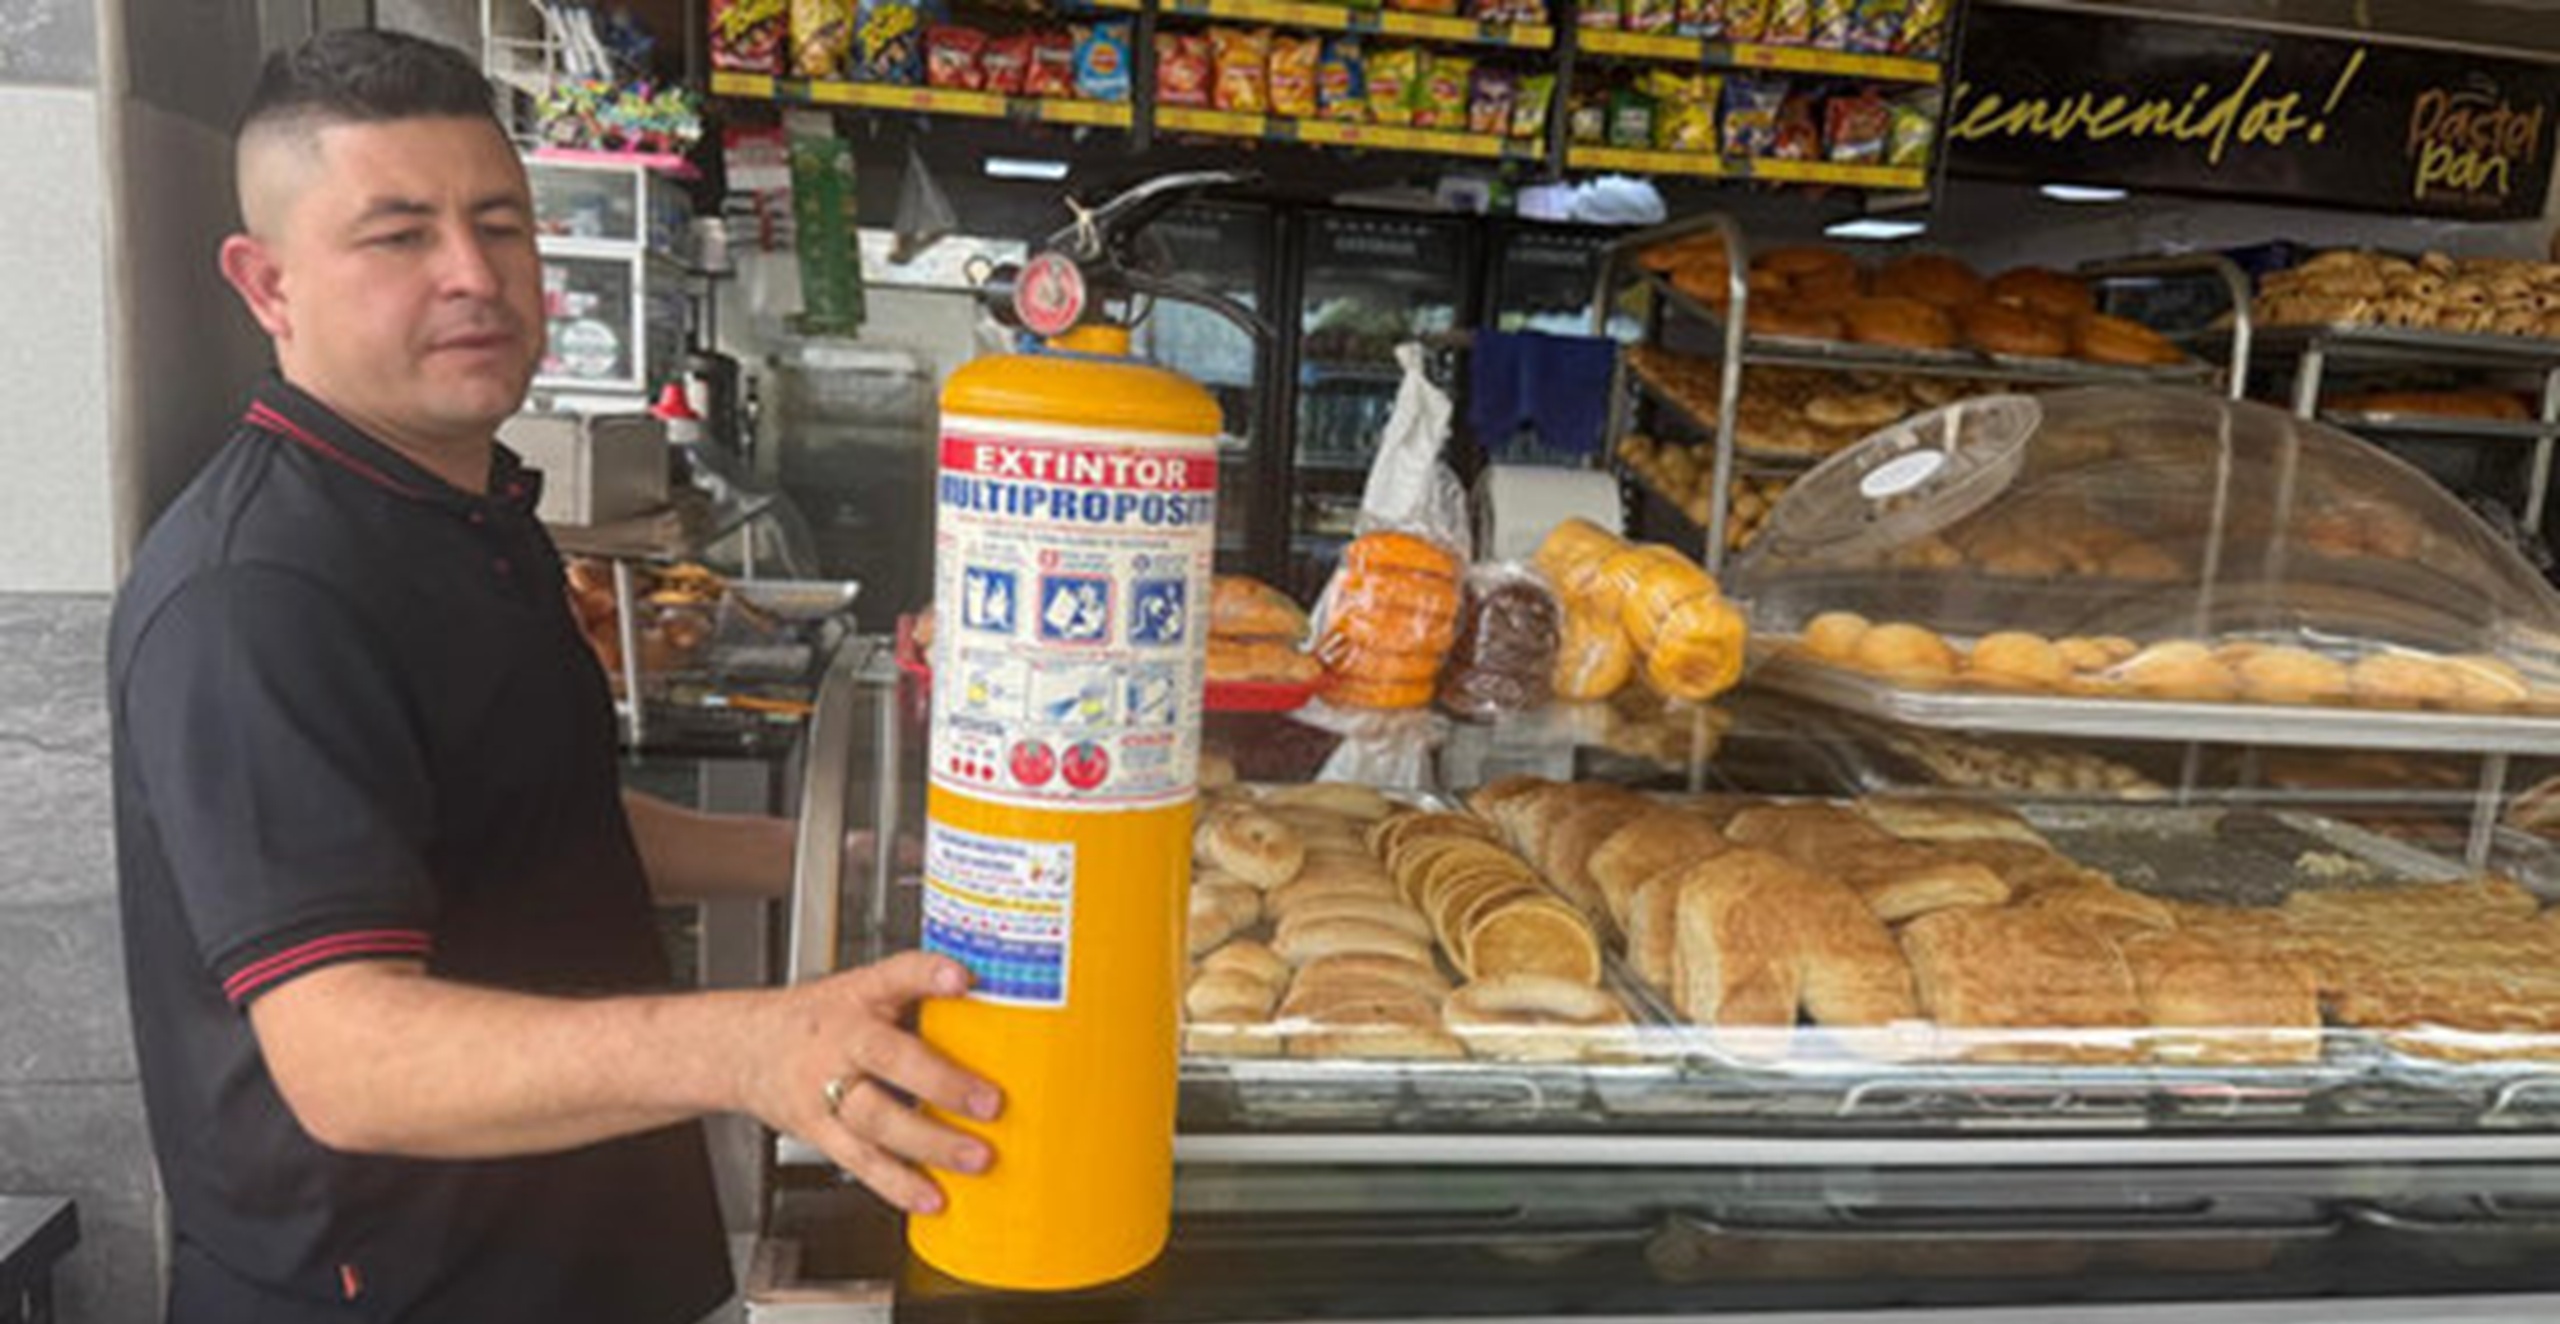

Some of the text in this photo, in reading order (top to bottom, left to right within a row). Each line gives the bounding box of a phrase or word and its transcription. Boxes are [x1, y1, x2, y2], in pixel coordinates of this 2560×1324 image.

[2414, 139, 2509, 199] pan
[974, 445, 1188, 488] EXTINTOR
[941, 474, 1215, 526] MULTIPROPOSIT
